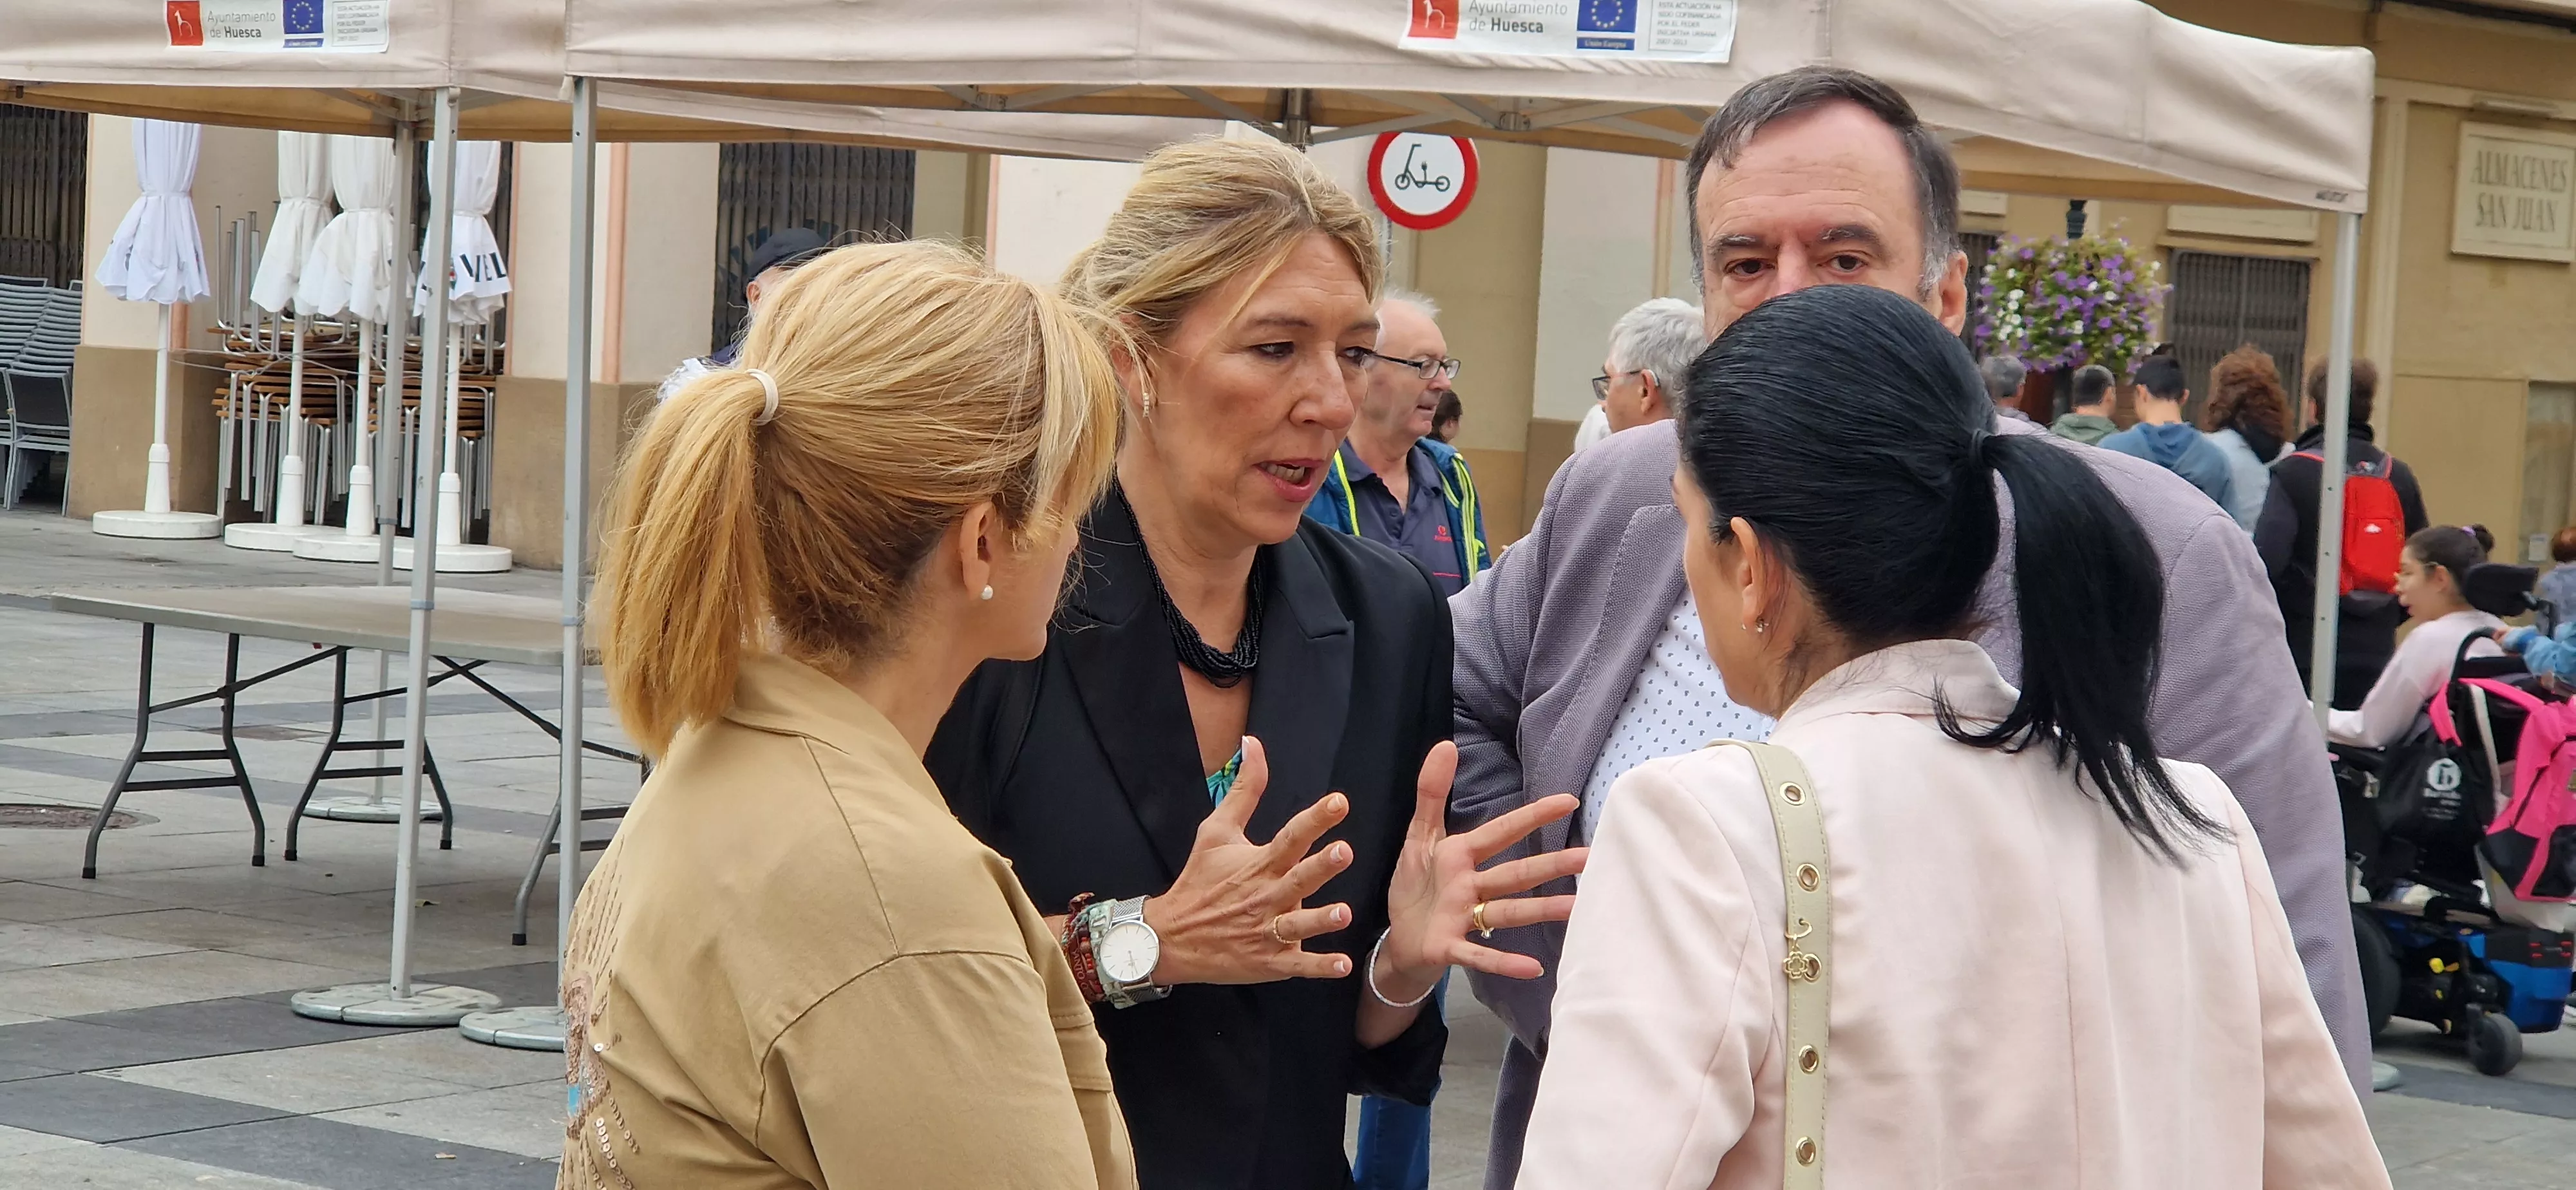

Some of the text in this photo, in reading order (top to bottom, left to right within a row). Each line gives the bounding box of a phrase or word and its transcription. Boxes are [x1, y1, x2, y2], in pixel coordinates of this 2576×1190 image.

[1468, 0, 1567, 16] Ayuntamiento
[207, 10, 276, 26] Ayuntamiento
[1469, 17, 1543, 33] de Huesca
[209, 26, 261, 38] de Huesca
[2470, 150, 2568, 193] ALMACENES
[2475, 192, 2559, 232] SAN JUAN
